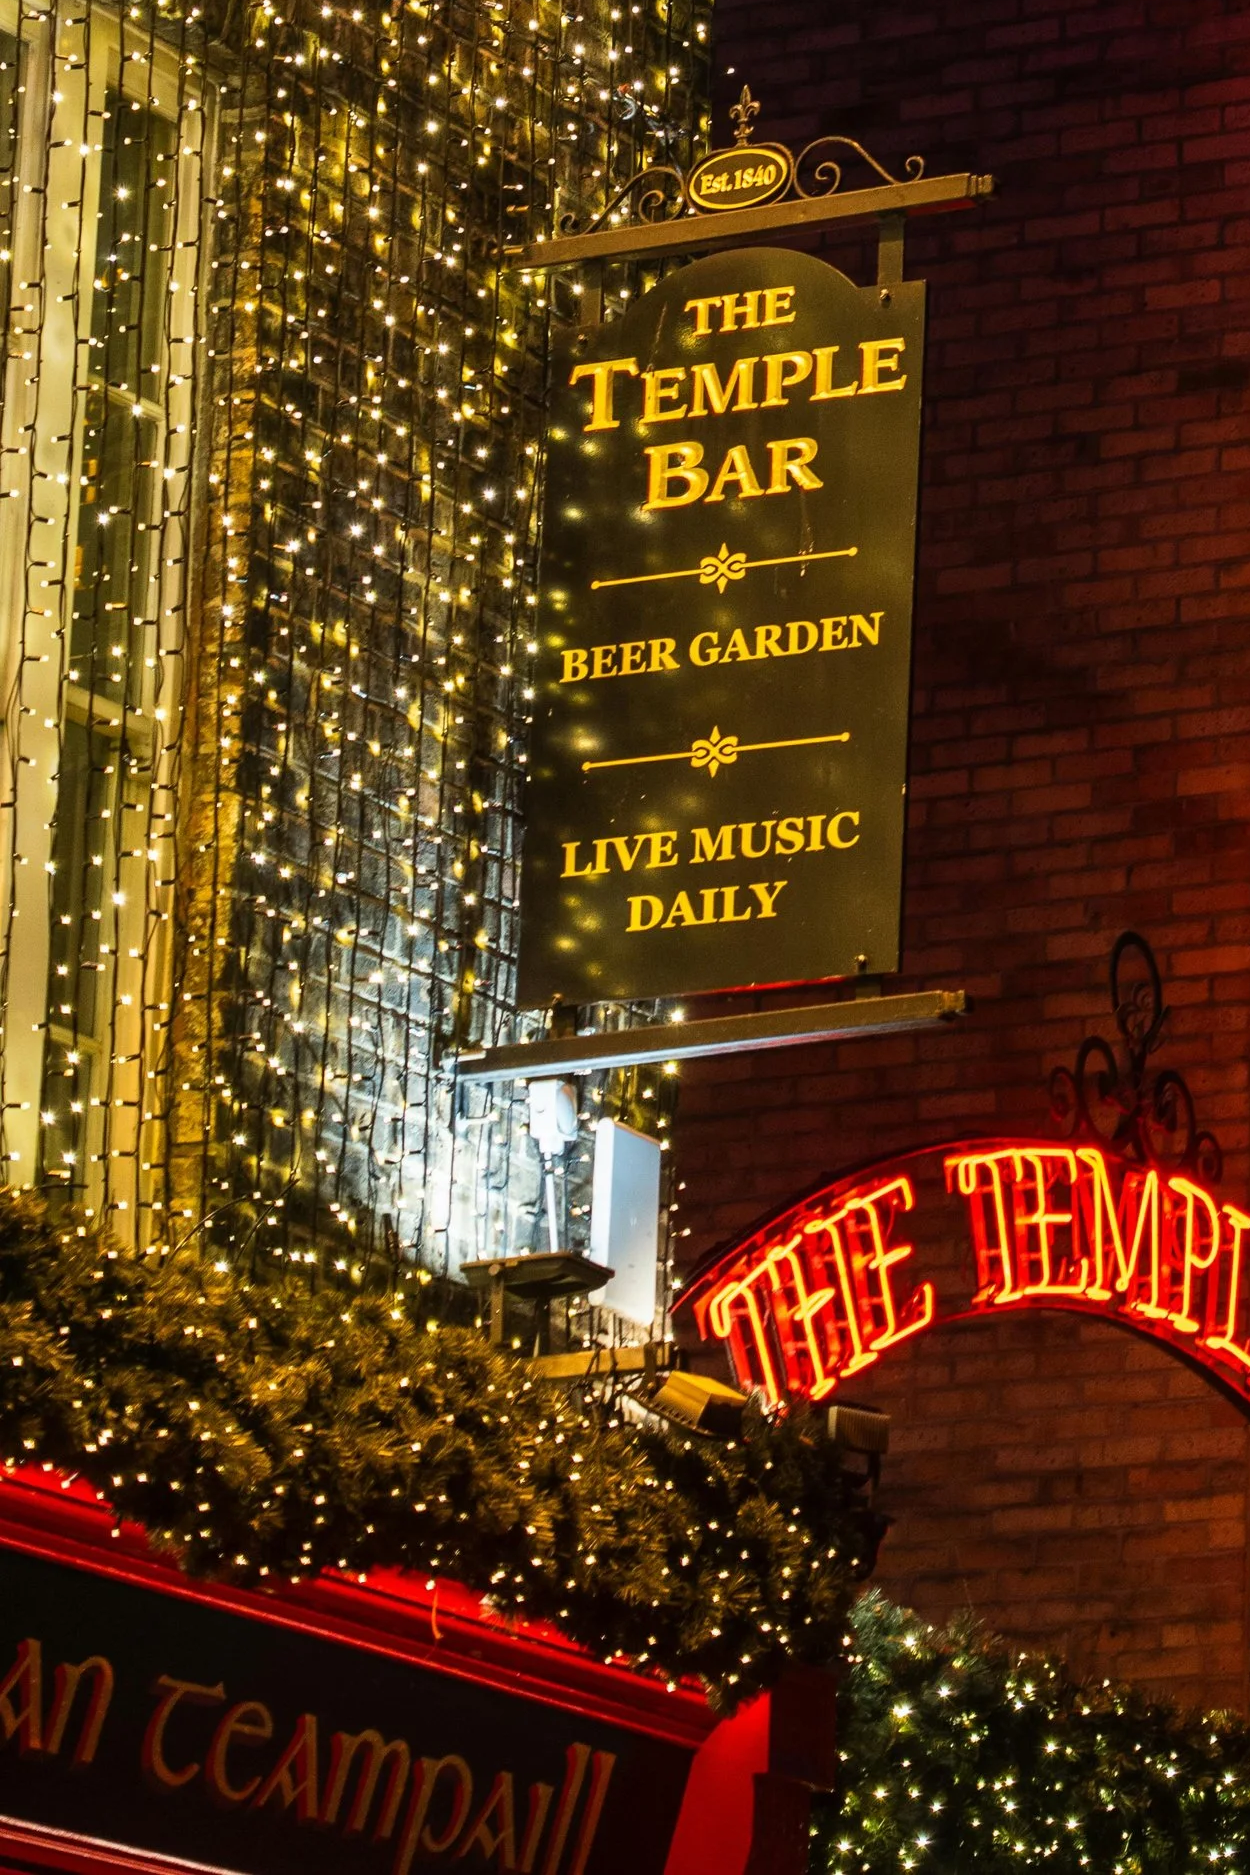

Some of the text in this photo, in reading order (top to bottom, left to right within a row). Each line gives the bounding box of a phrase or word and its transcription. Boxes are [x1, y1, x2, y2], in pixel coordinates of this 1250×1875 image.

[684, 284, 796, 337] THE
[569, 337, 908, 433] TEMPLE
[642, 437, 823, 512] BAR
[560, 612, 885, 684] BEER GARDEN
[560, 811, 861, 878] LIVE MUSIC
[626, 881, 788, 933] DAILY
[694, 1175, 935, 1409] THE
